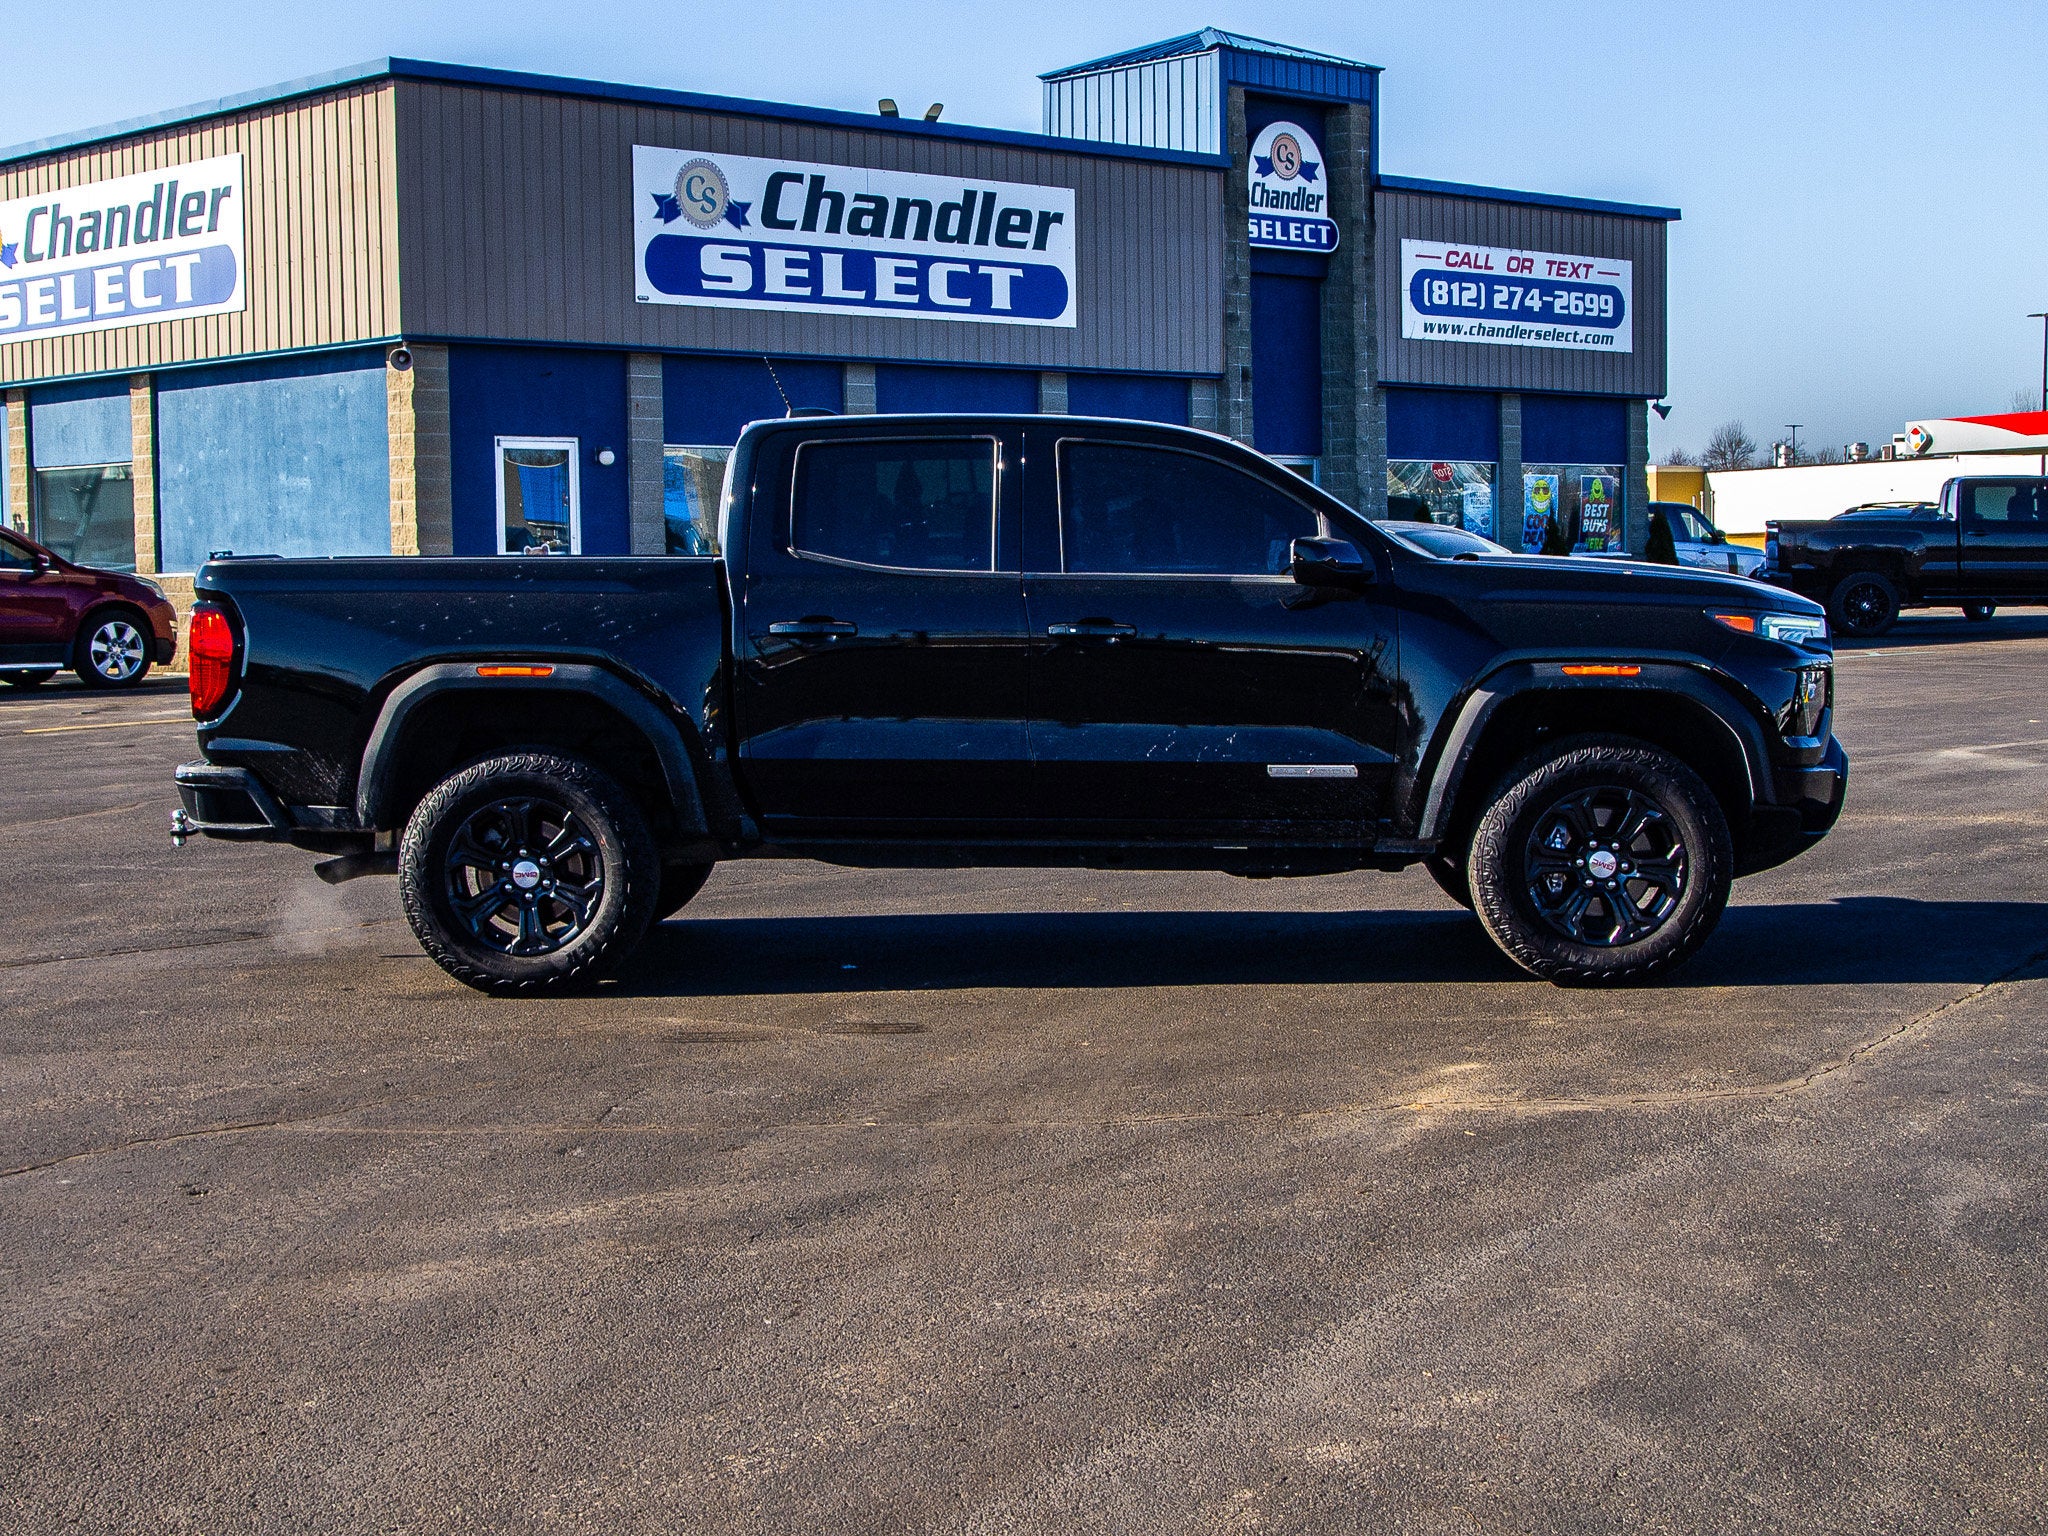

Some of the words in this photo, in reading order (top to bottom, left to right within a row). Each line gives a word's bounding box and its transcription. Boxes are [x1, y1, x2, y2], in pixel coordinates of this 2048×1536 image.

[760, 171, 1064, 251] Chandler
[1251, 182, 1324, 213] Chandler
[24, 180, 231, 264] Chandler
[1249, 218, 1330, 244] SELECT
[700, 244, 1024, 310] SELECT
[1445, 250, 1494, 271] CALL
[1507, 256, 1534, 275] OR
[1545, 260, 1594, 280] TEXT
[0, 252, 201, 329] SELECT
[1423, 278, 1486, 310] (812)
[1493, 285, 1614, 318] 274-2699
[1423, 322, 1614, 346] www.chandlerselect.com
[1582, 519, 1608, 533] BUYS
[1584, 503, 1610, 518] BEST
